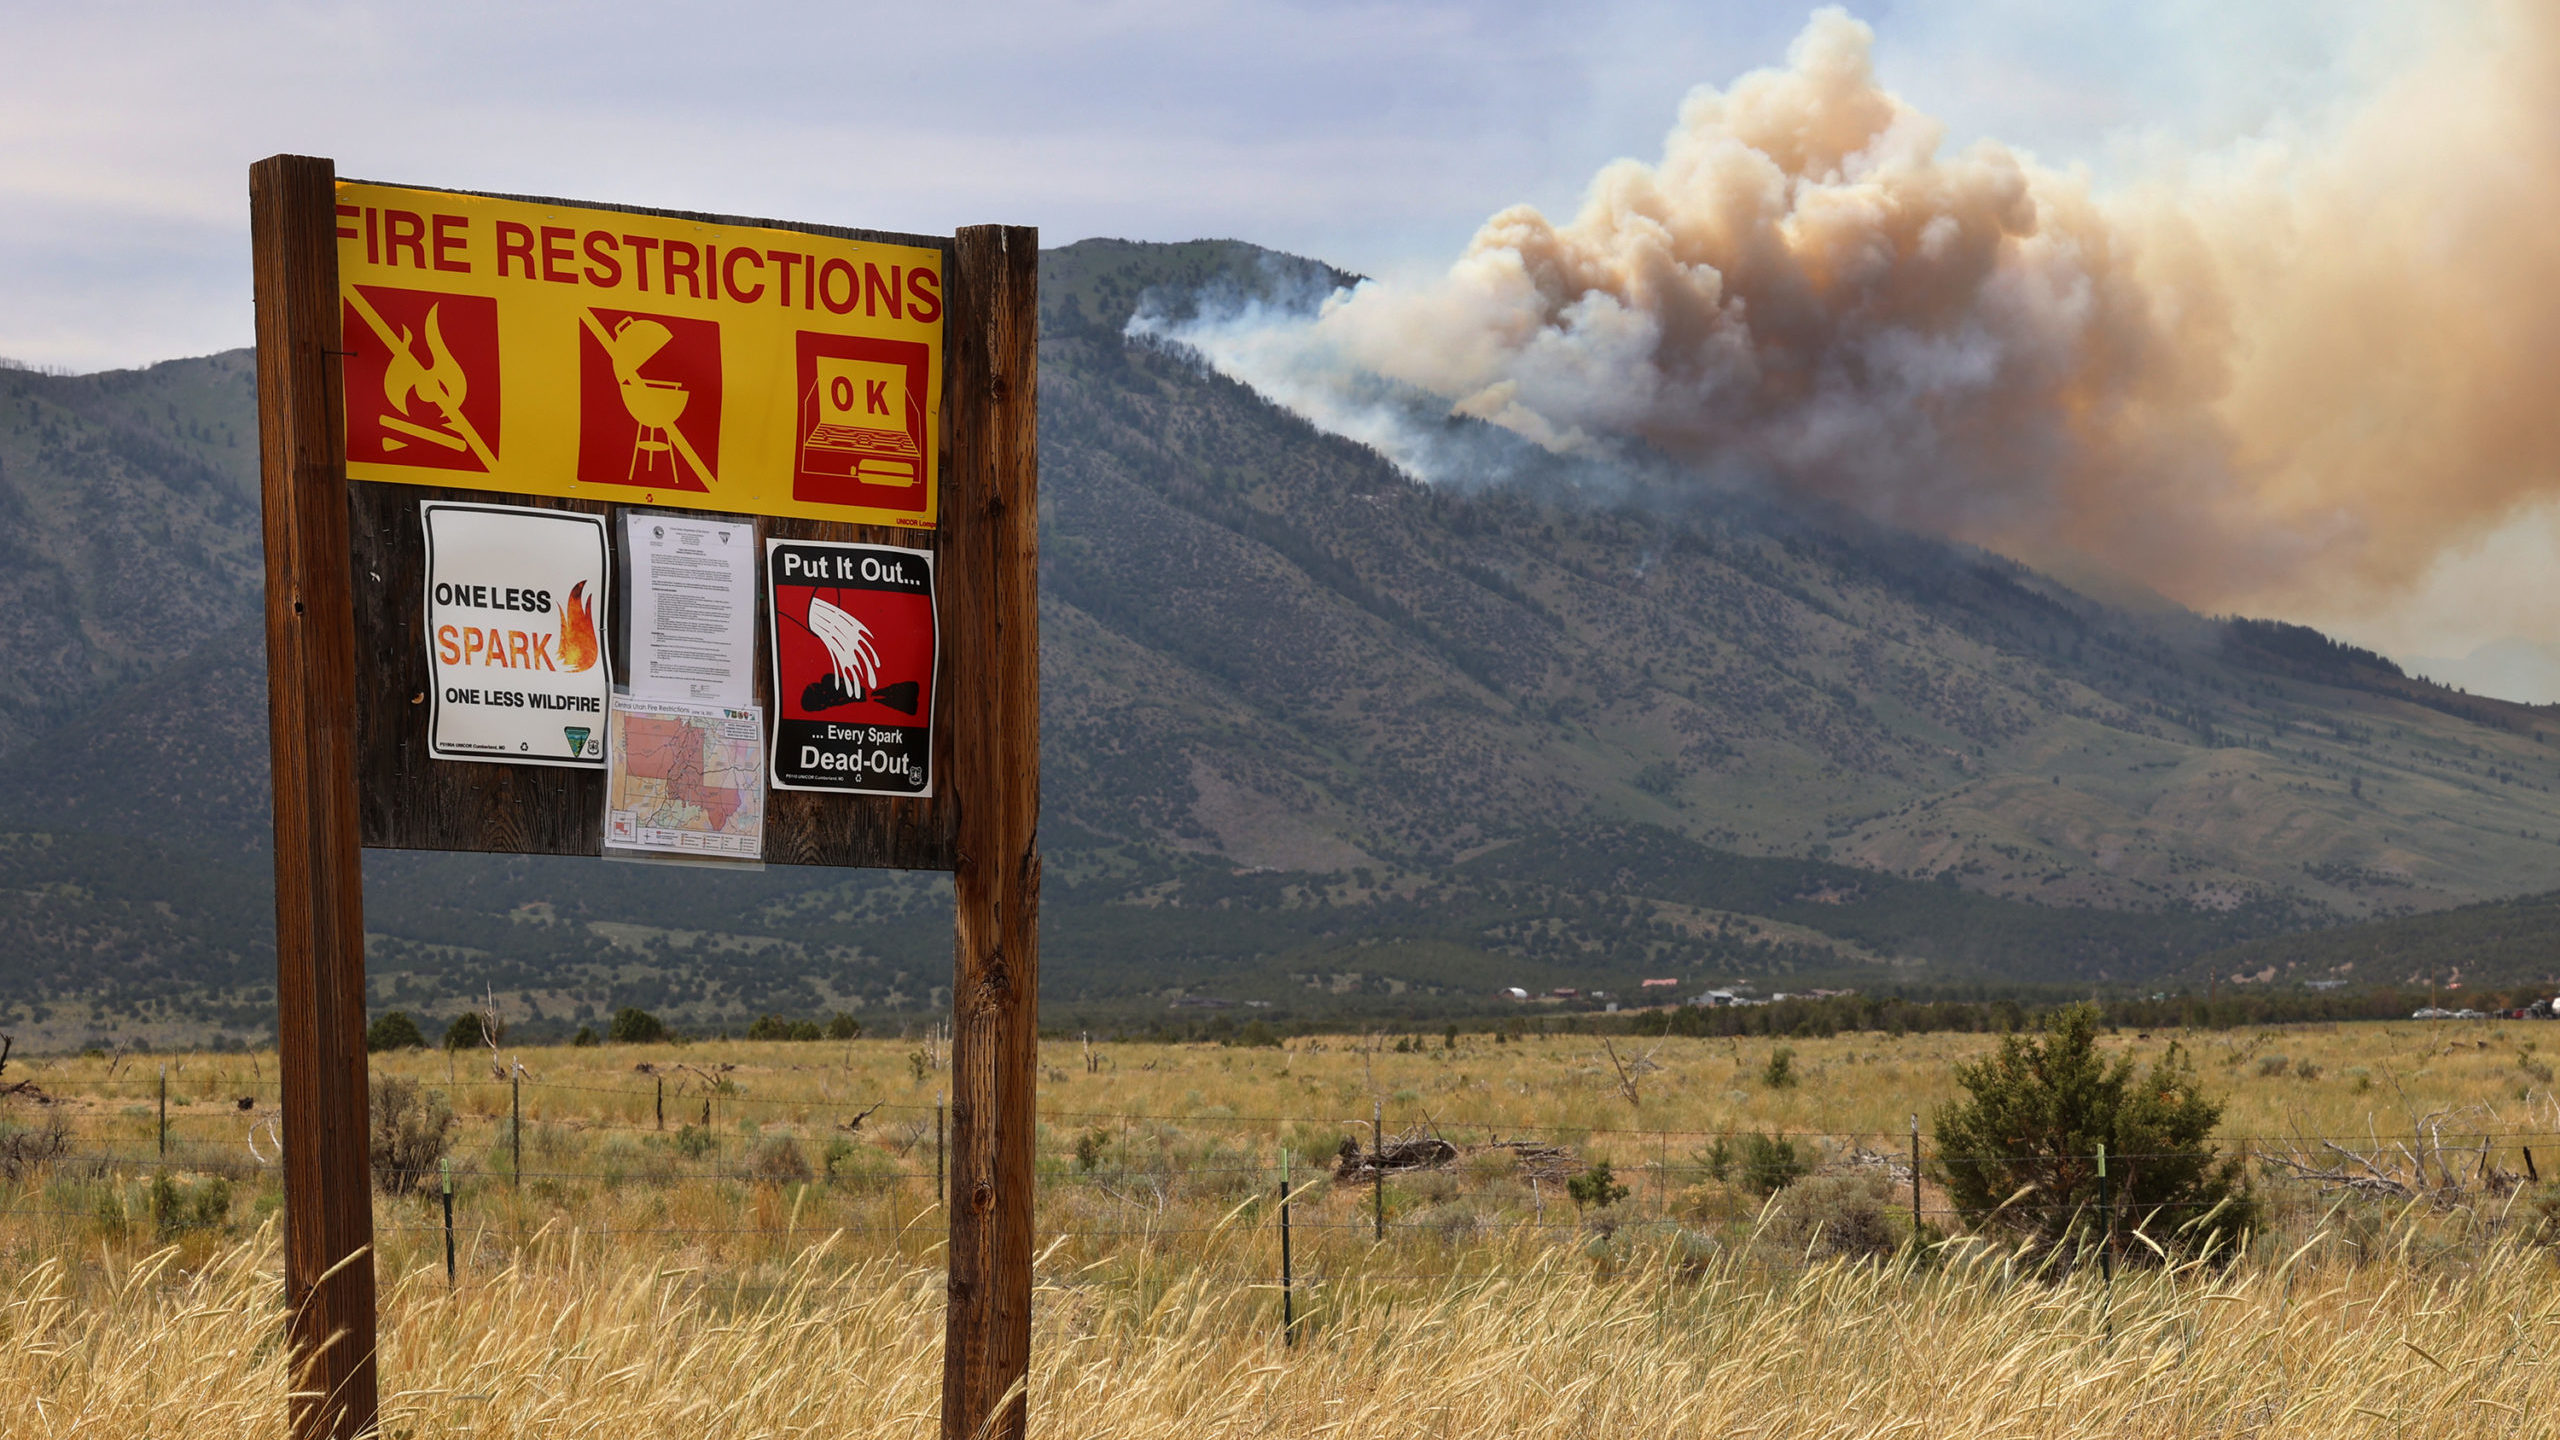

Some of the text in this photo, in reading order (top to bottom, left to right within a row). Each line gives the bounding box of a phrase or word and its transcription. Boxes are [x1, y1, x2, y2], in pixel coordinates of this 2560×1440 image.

[495, 220, 942, 323] RESTRICTIONS
[784, 553, 921, 586] Put It Out...
[435, 582, 552, 613] ONE LESS
[437, 624, 556, 672] SPARK
[445, 687, 600, 713] ONE LESS WILDFIRE
[827, 724, 864, 745] Every
[868, 727, 903, 746] Spark
[800, 745, 909, 775] Dead-Out
